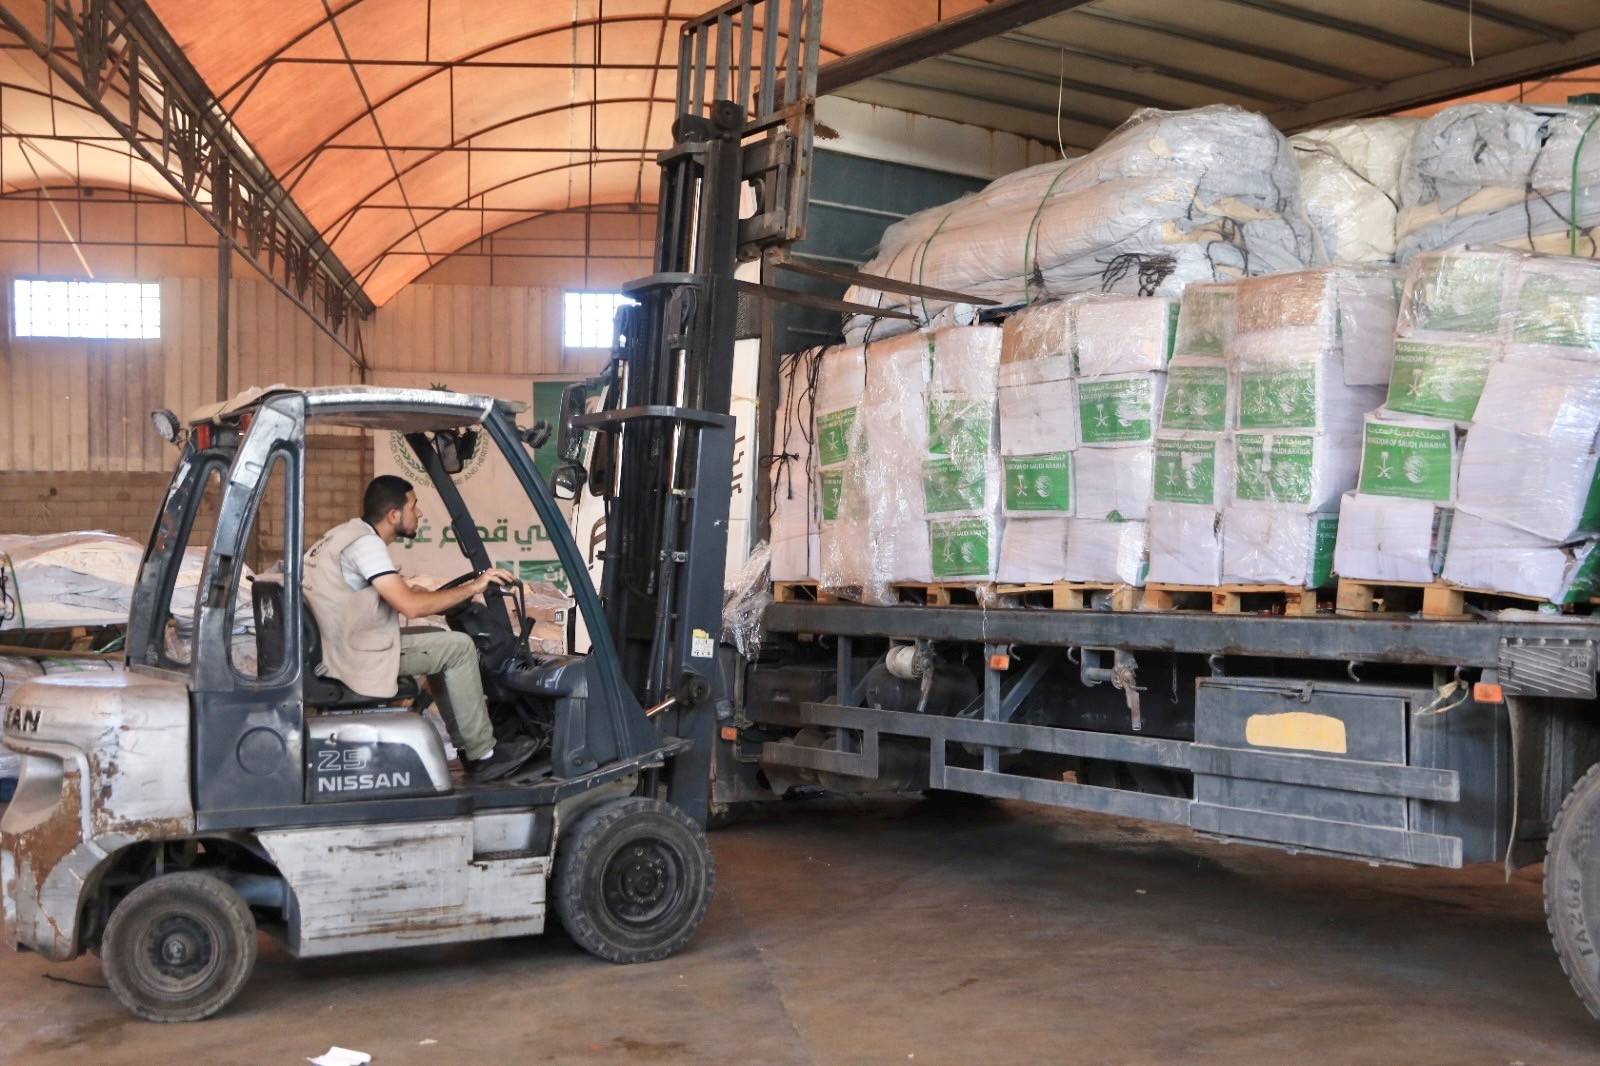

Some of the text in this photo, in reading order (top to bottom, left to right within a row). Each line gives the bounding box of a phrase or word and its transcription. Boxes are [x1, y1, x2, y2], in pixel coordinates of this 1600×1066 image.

[1418, 441, 1447, 449] ARABIA
[317, 749, 367, 772] 25
[318, 771, 410, 793] NISSAN
